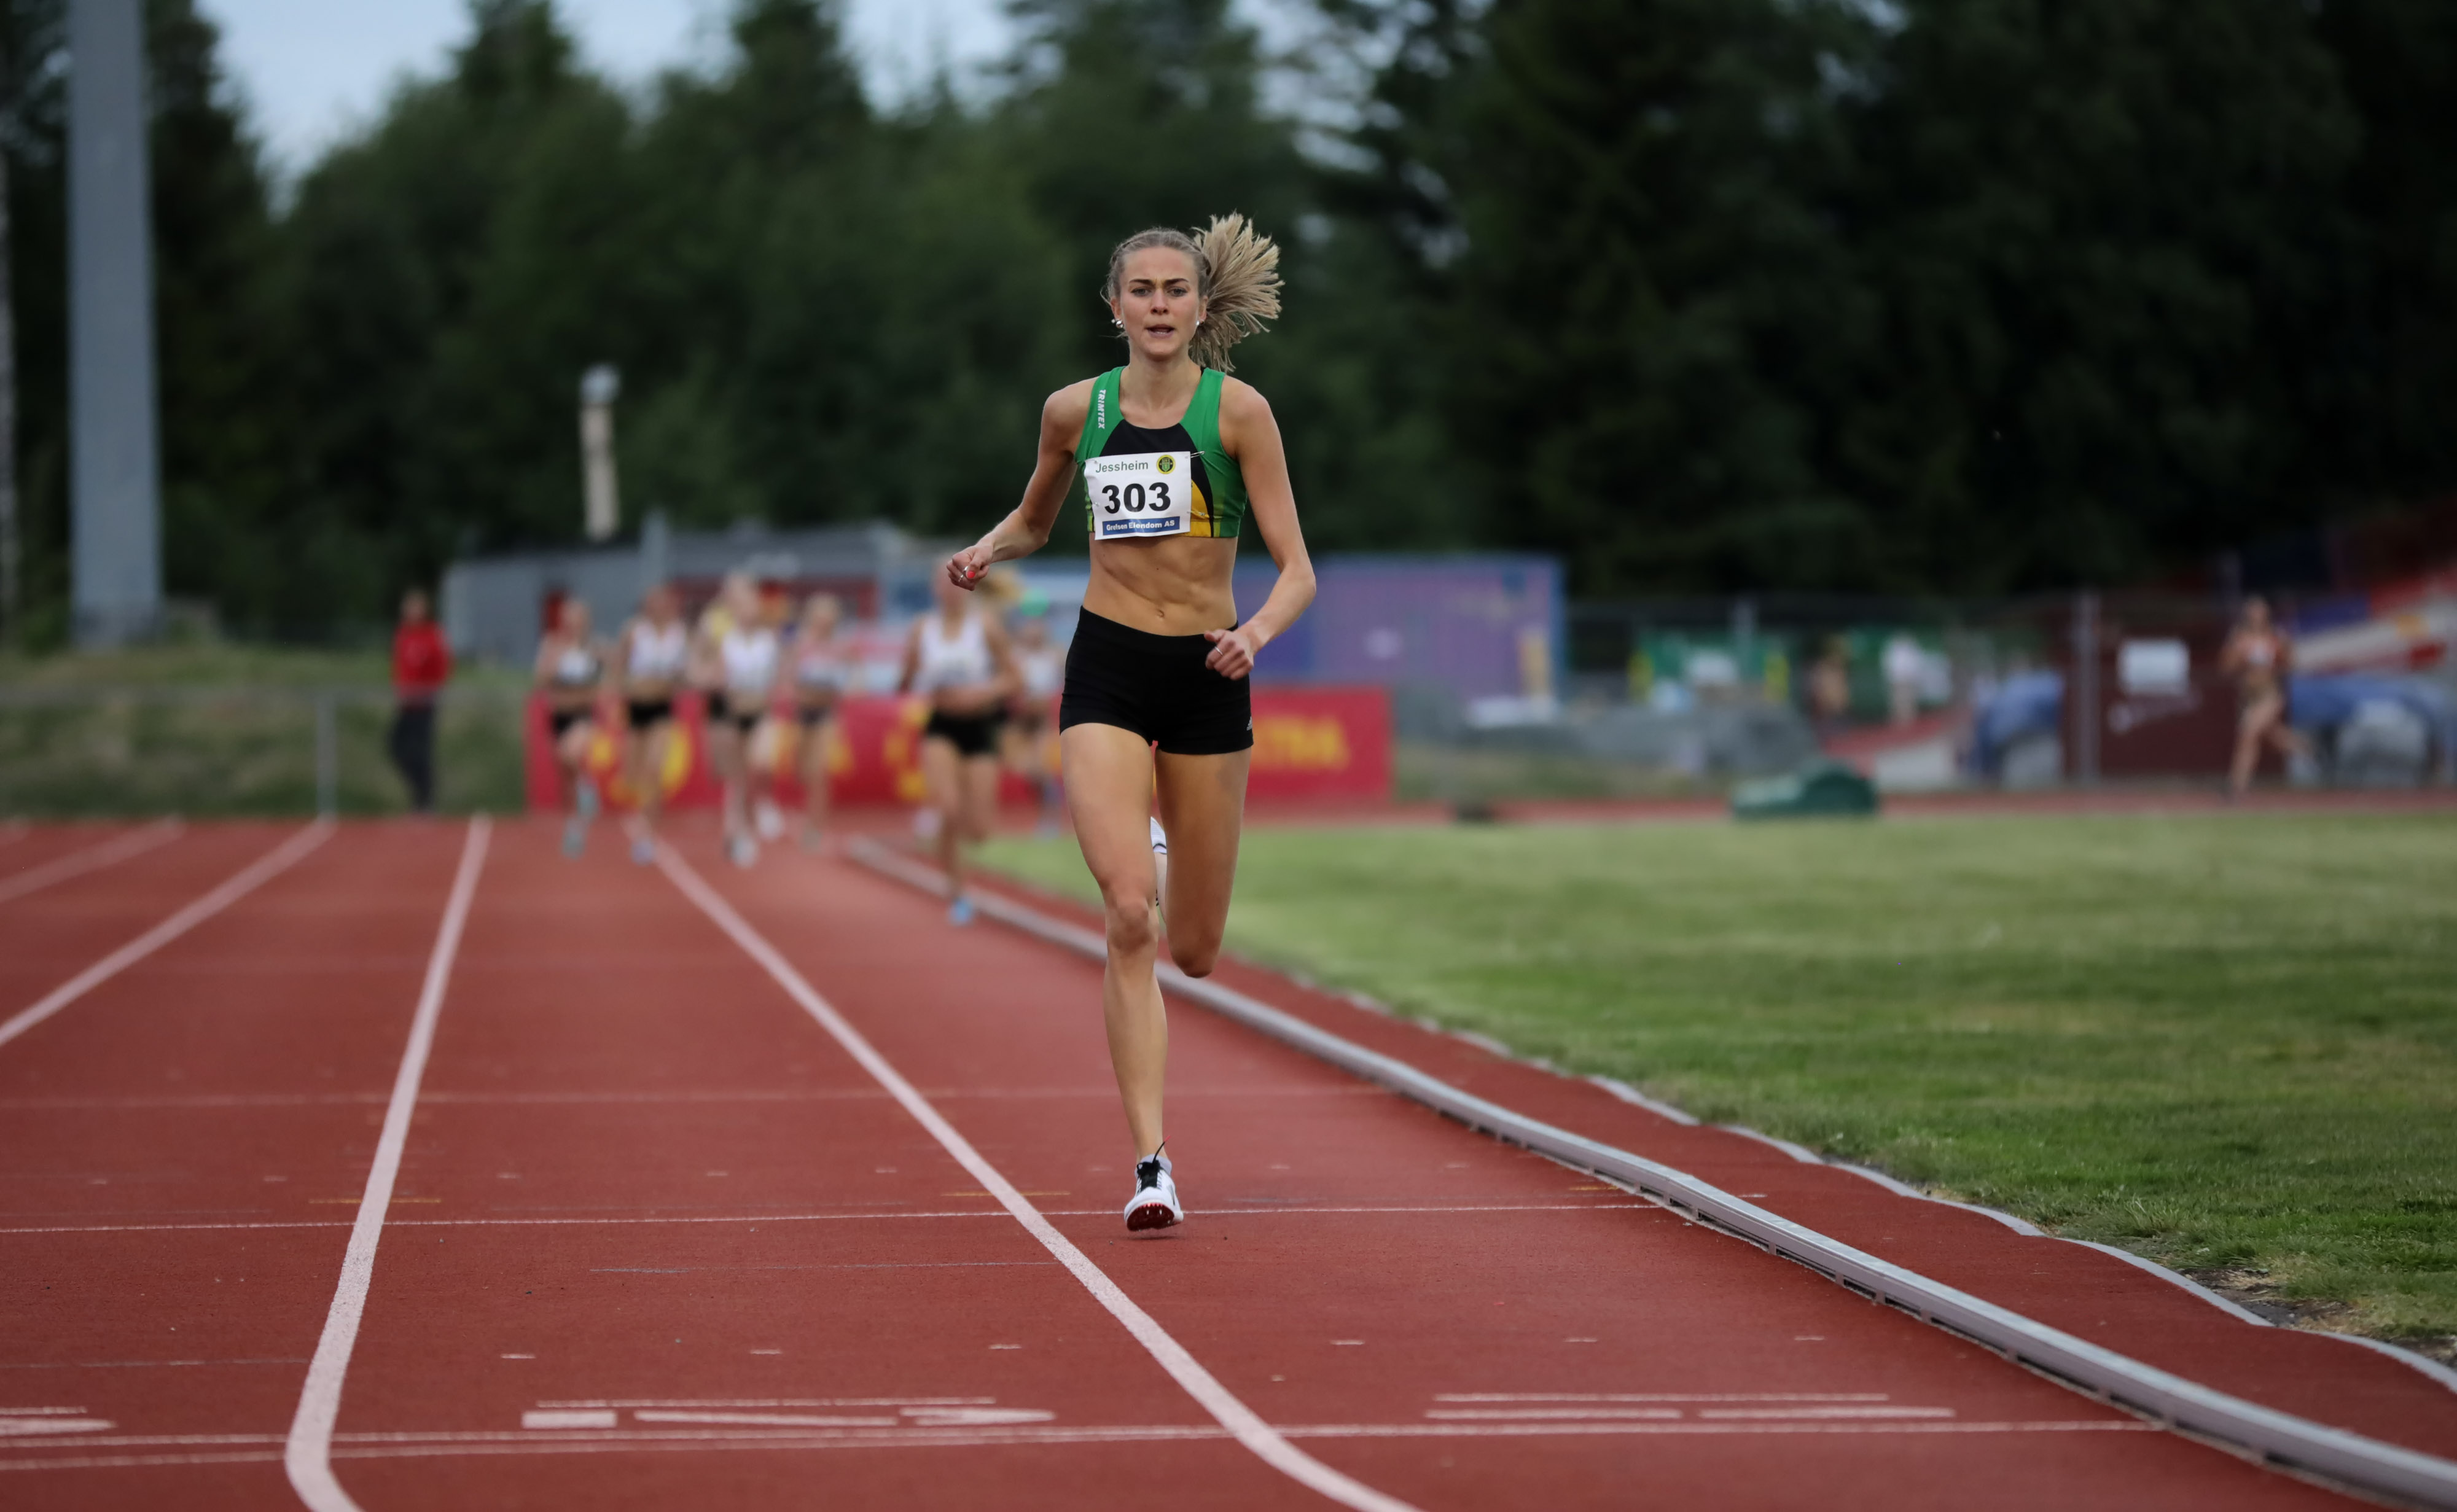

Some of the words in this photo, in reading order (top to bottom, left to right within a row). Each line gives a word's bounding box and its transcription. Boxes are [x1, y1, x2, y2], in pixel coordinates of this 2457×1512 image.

[1097, 389, 1106, 429] TRIMTEX
[1095, 460, 1149, 473] Jessheim
[1101, 481, 1171, 514] 303
